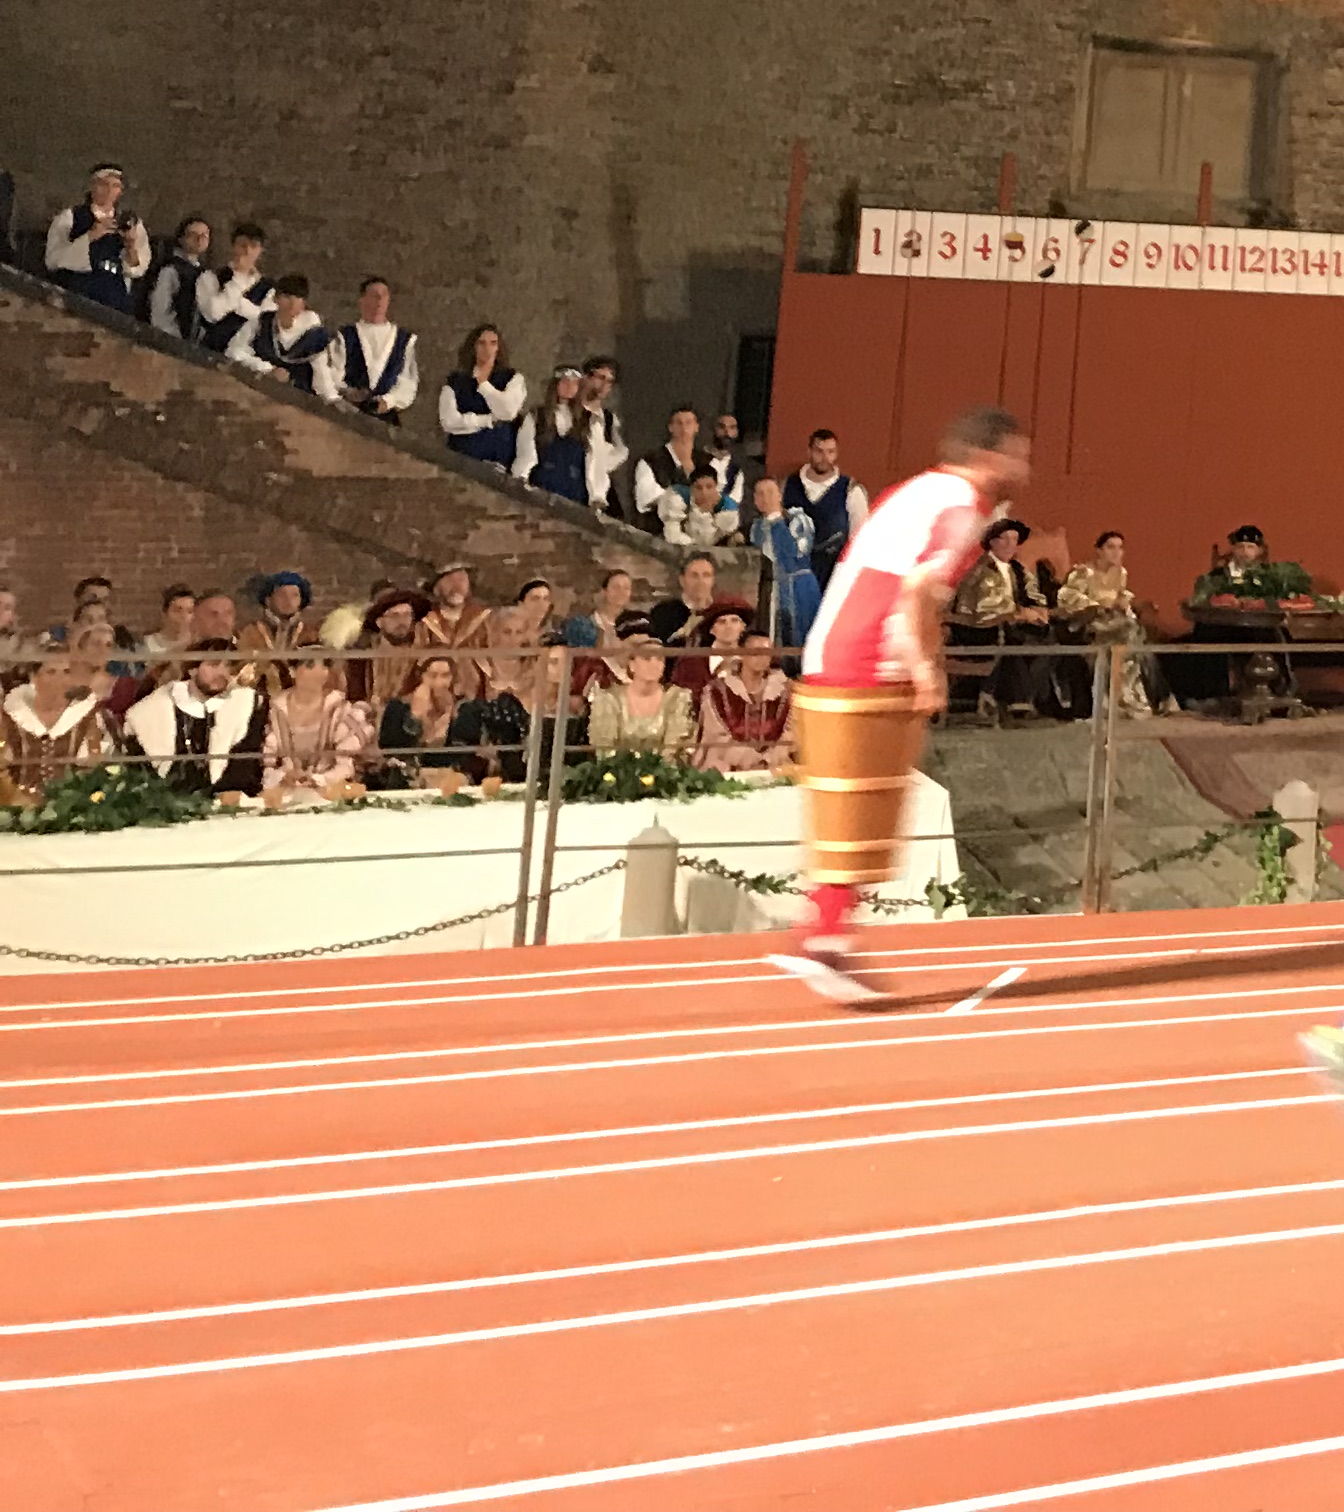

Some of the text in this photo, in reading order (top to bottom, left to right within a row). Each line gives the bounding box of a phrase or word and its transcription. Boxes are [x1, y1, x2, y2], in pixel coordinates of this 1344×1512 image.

[873, 228, 881, 256] 1
[938, 231, 957, 260] 3
[973, 233, 992, 261] 4
[1042, 236, 1061, 262] 6
[1076, 236, 1096, 265] 7
[1110, 240, 1130, 269] 8
[1144, 241, 1163, 269] 9
[1173, 243, 1201, 272] 10
[1207, 243, 1230, 272] 11
[1239, 245, 1267, 273] 12
[1270, 247, 1300, 276] 13
[1302, 249, 1330, 277] 14
